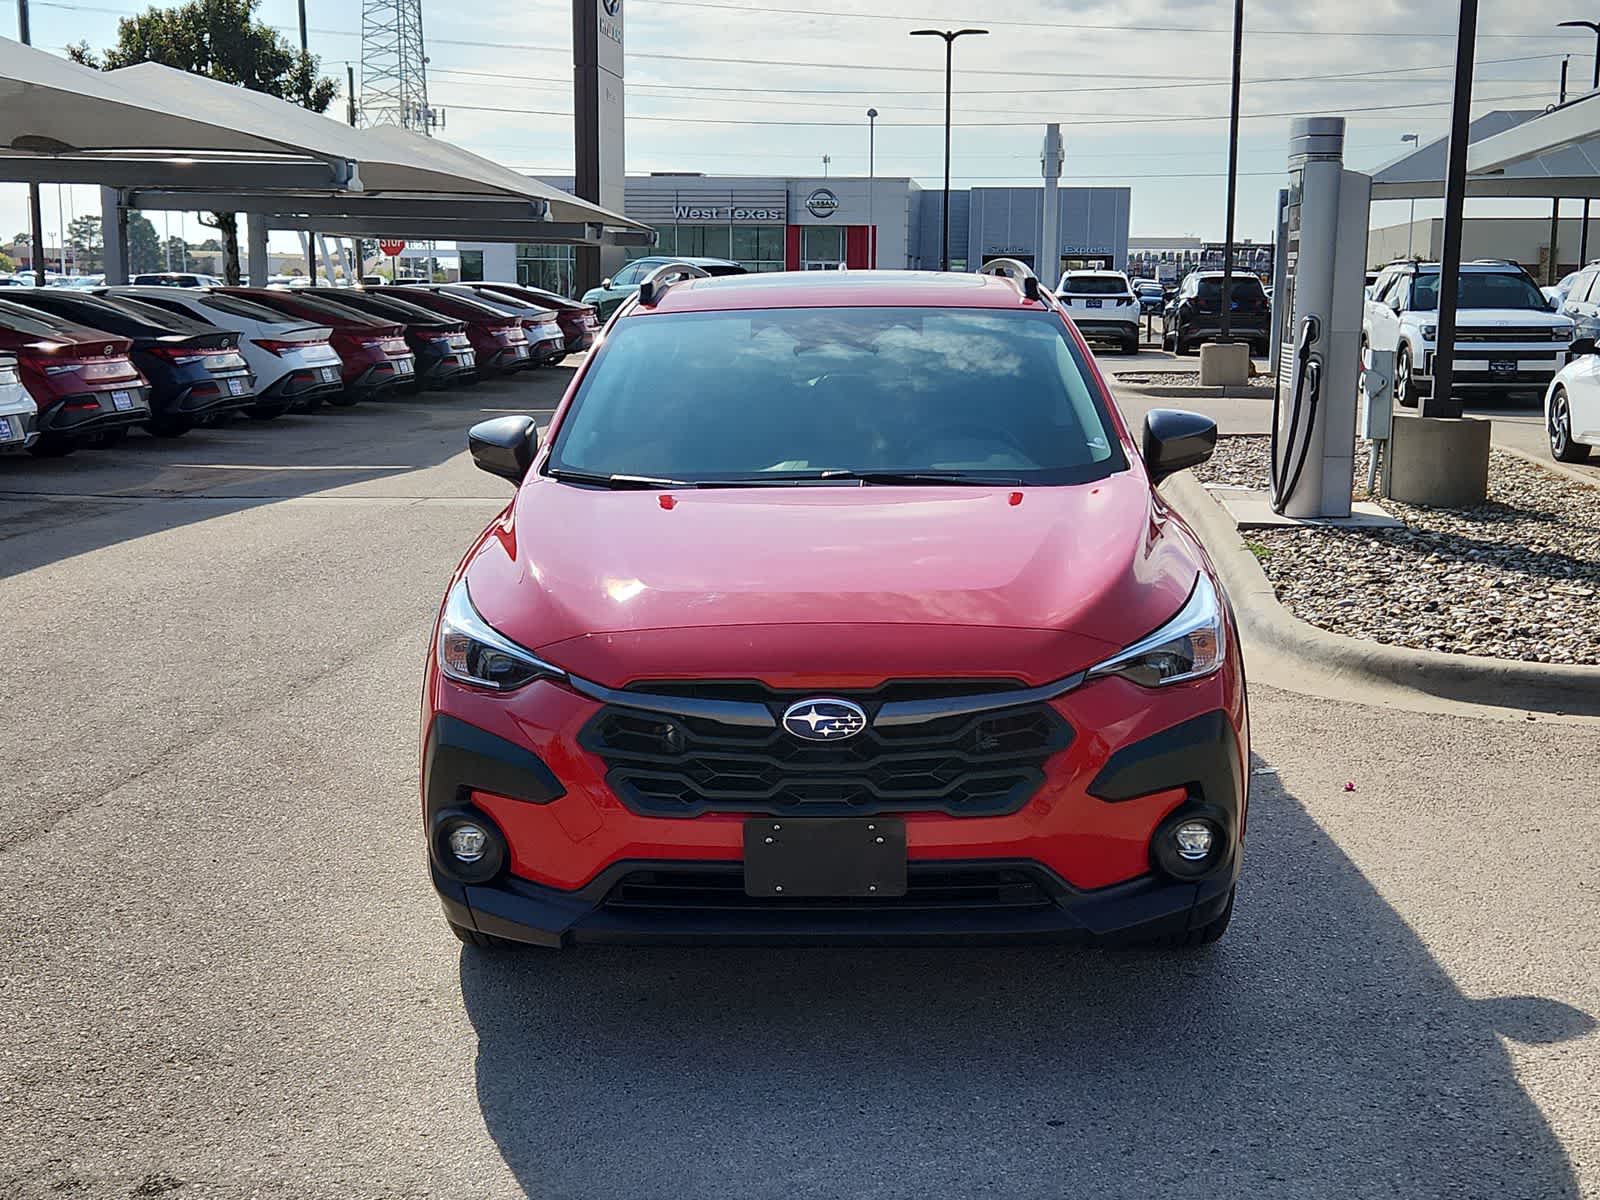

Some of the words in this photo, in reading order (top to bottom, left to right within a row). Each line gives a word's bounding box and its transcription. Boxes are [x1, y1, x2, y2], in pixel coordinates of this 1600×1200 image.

[808, 200, 837, 208] NISSAN
[672, 206, 718, 219] West
[726, 206, 780, 220] Texas
[380, 239, 404, 248] STOP
